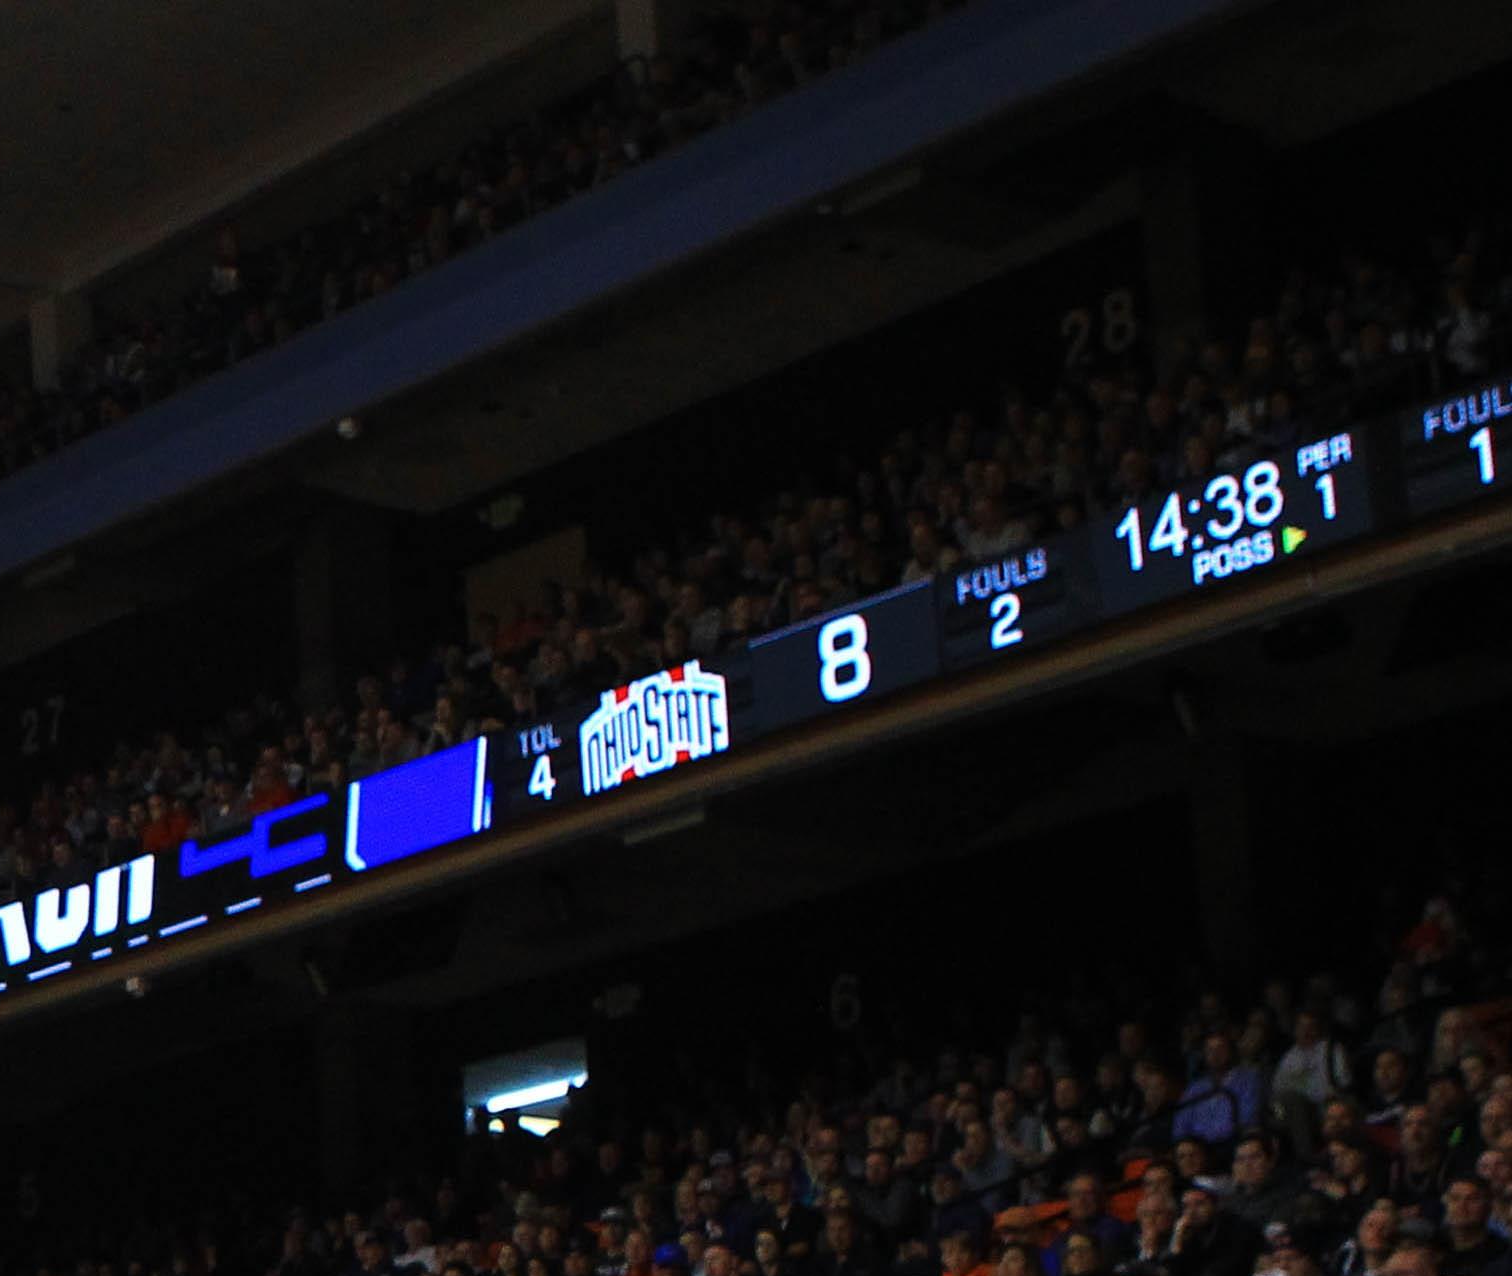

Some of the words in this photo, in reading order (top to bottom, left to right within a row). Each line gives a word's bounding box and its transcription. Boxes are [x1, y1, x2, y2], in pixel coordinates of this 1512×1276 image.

[1423, 384, 1512, 441] FOUL
[1297, 433, 1351, 477] PER
[1468, 426, 1495, 484] 1
[1115, 460, 1284, 571] 14:38
[1314, 473, 1336, 520] 1
[957, 549, 1048, 605] FOULS
[1193, 531, 1274, 585] POSS
[989, 592, 1023, 649] 2
[817, 613, 872, 702] 8
[518, 722, 562, 758] TOL
[527, 754, 557, 801] 4
